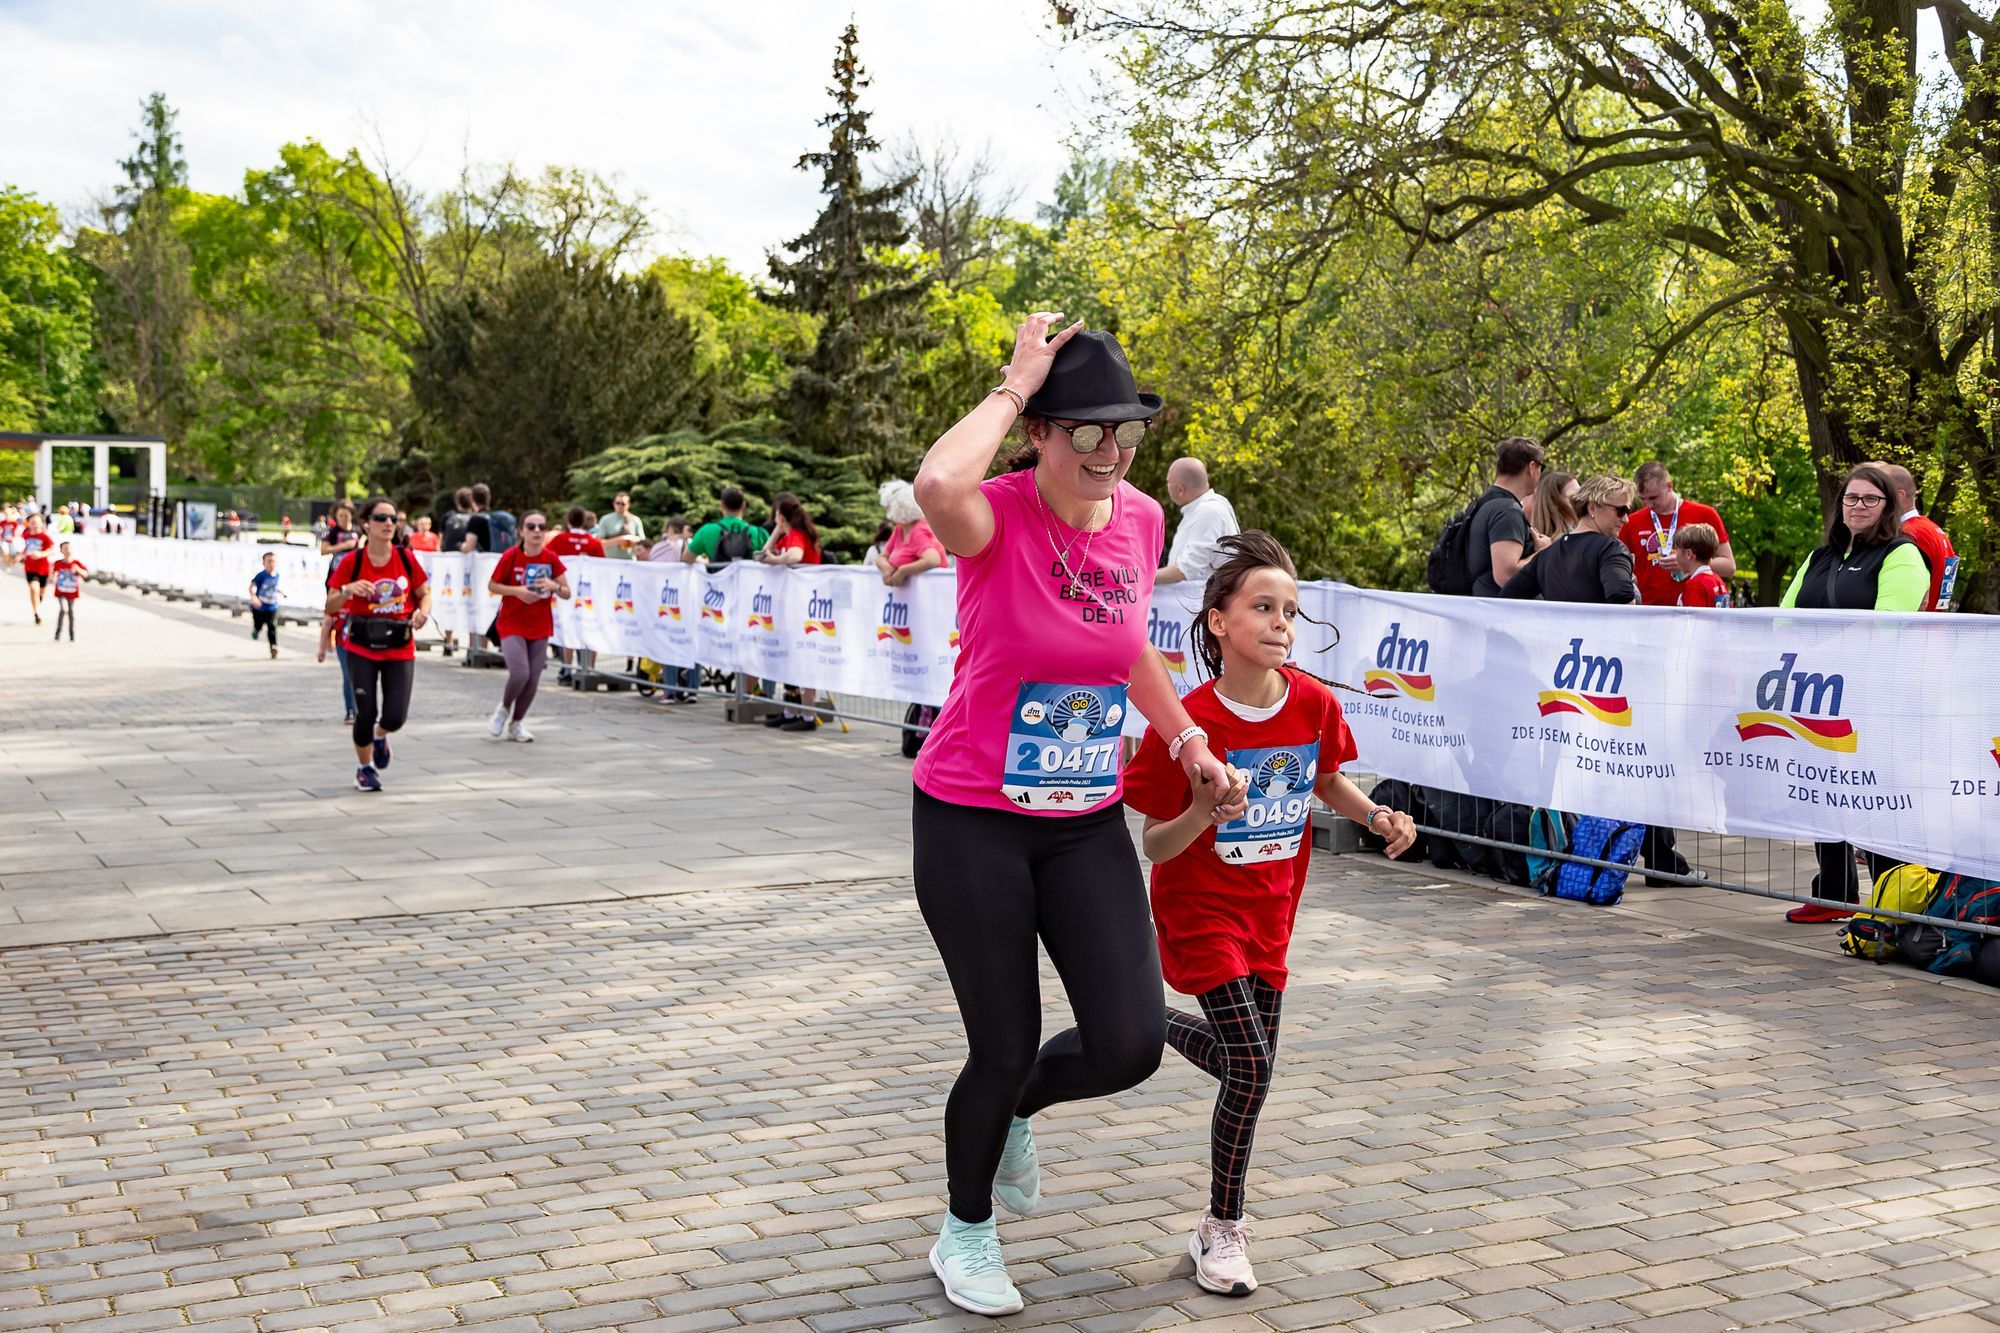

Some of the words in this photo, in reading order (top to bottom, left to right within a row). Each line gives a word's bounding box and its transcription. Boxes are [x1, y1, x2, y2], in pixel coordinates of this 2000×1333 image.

[1111, 565, 1139, 584] VÍLY
[661, 579, 679, 605] dm
[753, 585, 772, 614] dm
[808, 589, 833, 619] dm
[1102, 588, 1137, 605] PRO
[883, 593, 908, 626] dm
[1148, 608, 1181, 649] dm
[1376, 622, 1429, 673] dm
[1554, 638, 1623, 694] dm
[1756, 653, 1844, 716] dm
[1027, 707, 1040, 715] dm
[1344, 702, 1361, 714] ZDE
[1365, 703, 1388, 718] JSEM
[1392, 706, 1445, 727] ČLOVĚKEM
[1392, 727, 1411, 742] ZDE
[1414, 732, 1466, 747] NAKUPUJI
[1512, 726, 1534, 739] ZDE
[1539, 727, 1571, 744] JSEM
[1576, 732, 1647, 756] ČLOVĚKEM
[1017, 742, 1115, 773] 20477
[1577, 755, 1601, 773] ZDE
[1606, 761, 1676, 778] NAKUPUJI
[1704, 752, 1733, 765] ZDE
[1739, 753, 1779, 772] JSEM
[1786, 758, 1877, 785] ČLOVĚKEM
[1788, 785, 1819, 804] ZDE
[1826, 791, 1912, 811] NAKUPUJI
[1950, 780, 1986, 795] ZDE
